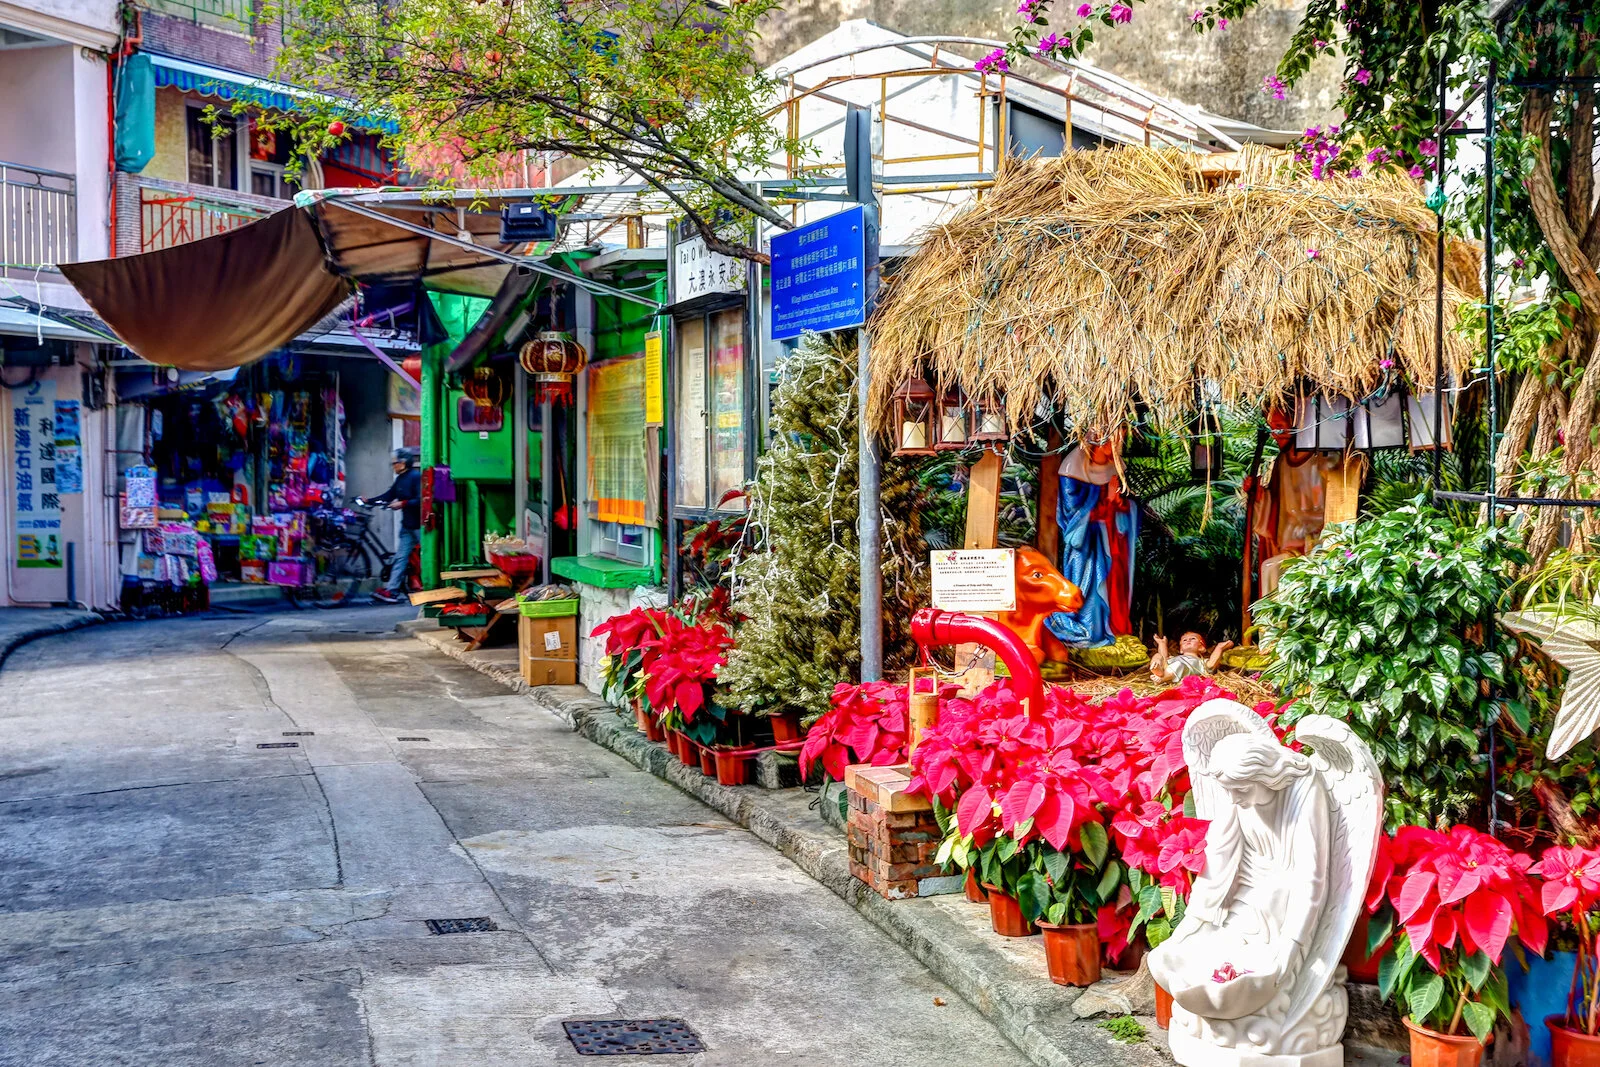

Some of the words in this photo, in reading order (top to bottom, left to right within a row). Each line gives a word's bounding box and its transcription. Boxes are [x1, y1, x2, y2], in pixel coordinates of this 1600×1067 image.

[680, 249, 689, 265] Tai
[691, 246, 696, 261] O
[1019, 697, 1030, 718] 1
